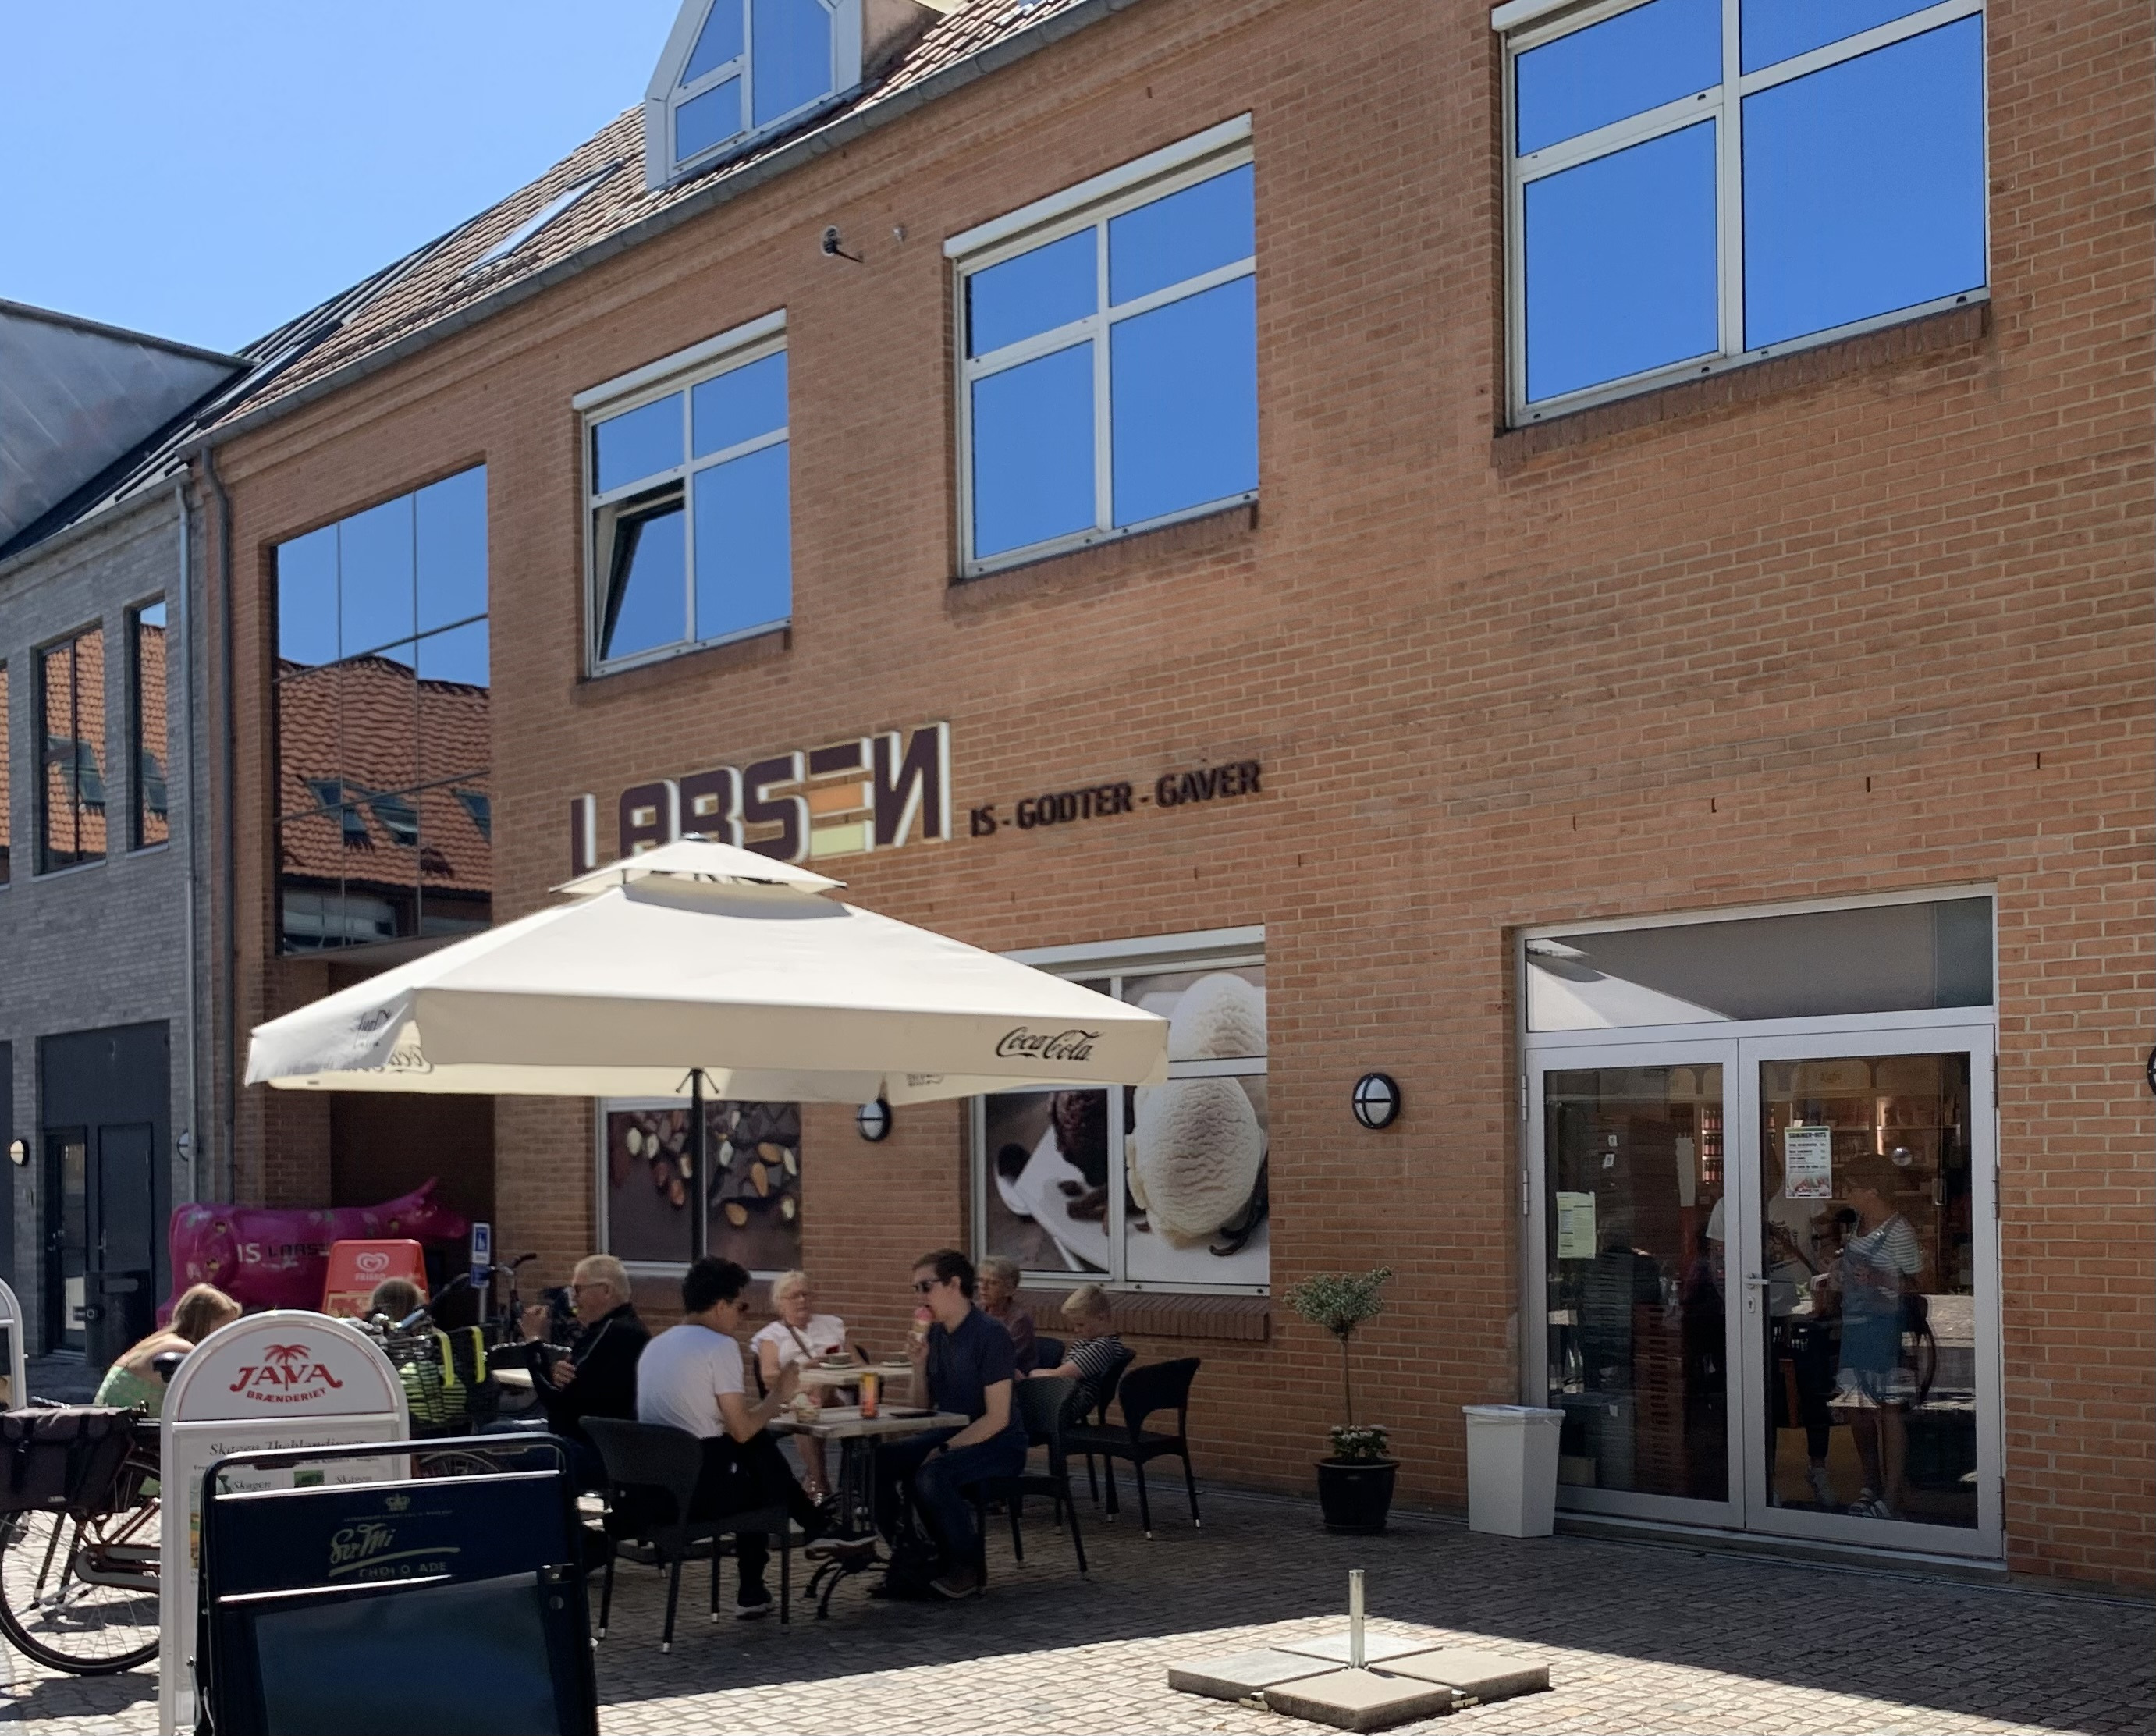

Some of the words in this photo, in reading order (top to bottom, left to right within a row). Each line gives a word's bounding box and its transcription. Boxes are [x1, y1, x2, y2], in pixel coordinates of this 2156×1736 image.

[571, 720, 951, 877] LARSEN
[970, 803, 996, 837] IS
[1017, 782, 1133, 830] GODTER
[1156, 759, 1262, 808] GAVER
[229, 1363, 343, 1392] JAVA
[246, 1387, 327, 1403] BRÆNDERIET
